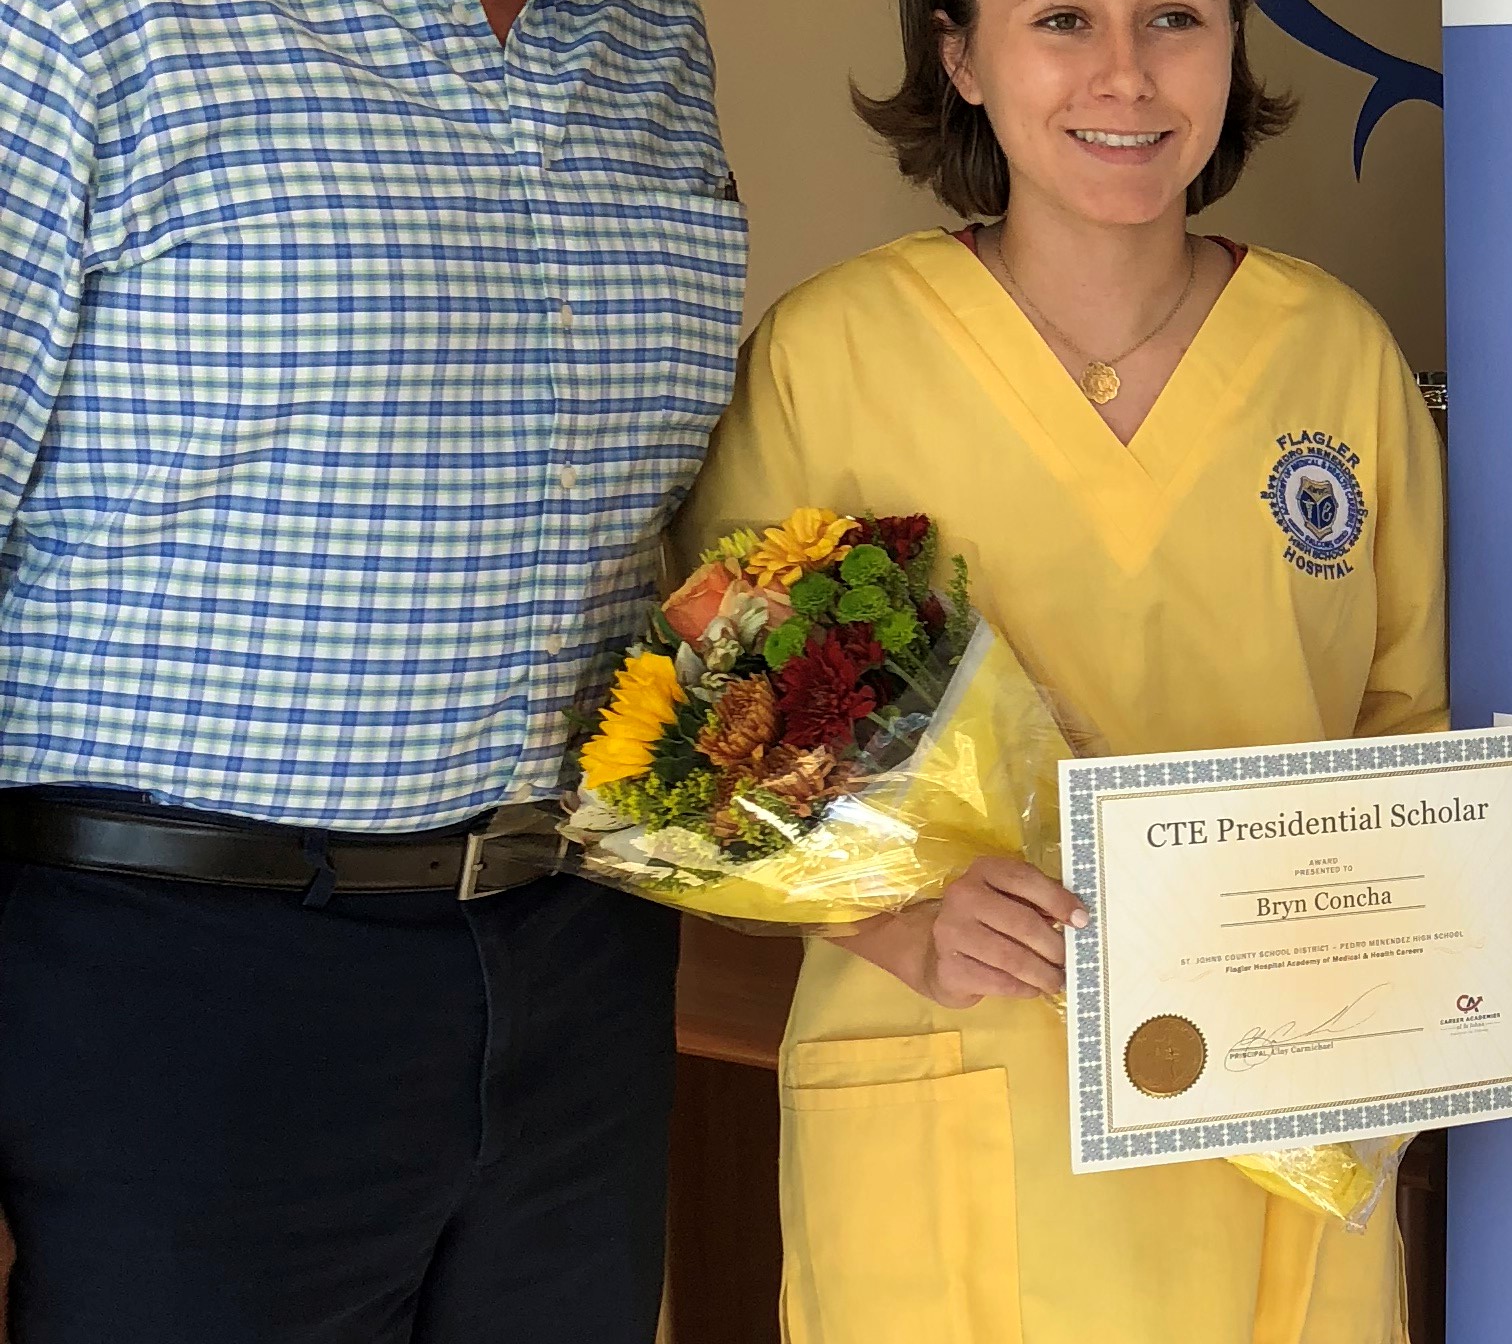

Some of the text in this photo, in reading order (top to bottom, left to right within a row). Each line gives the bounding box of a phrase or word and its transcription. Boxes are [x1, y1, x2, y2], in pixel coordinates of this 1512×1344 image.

[1273, 448, 1303, 473] PEDRO
[1276, 430, 1360, 469] FLAGLER
[1283, 545, 1353, 580] HOSPITAL
[1146, 797, 1489, 848] CTE Presidential Scholar
[1294, 864, 1353, 876] PRESENTED TO
[1308, 857, 1339, 866] AWARD
[1256, 886, 1392, 920] Bryn Concha
[1224, 952, 1257, 962] COUNTY
[1259, 948, 1292, 958] SCHOOL
[1293, 944, 1330, 955] DISTRICT
[1340, 940, 1367, 950] PEDRO
[1368, 936, 1411, 947] MENENDEZ
[1412, 934, 1432, 942] HIGH
[1434, 930, 1464, 940] SCHOOL
[1225, 964, 1252, 974] Flagler
[1253, 960, 1285, 971] Hospital
[1286, 957, 1321, 967] Academy
[1322, 956, 1331, 964] of
[1332, 952, 1361, 963] Medical
[1370, 949, 1395, 959] Health
[1396, 947, 1424, 957] Careers
